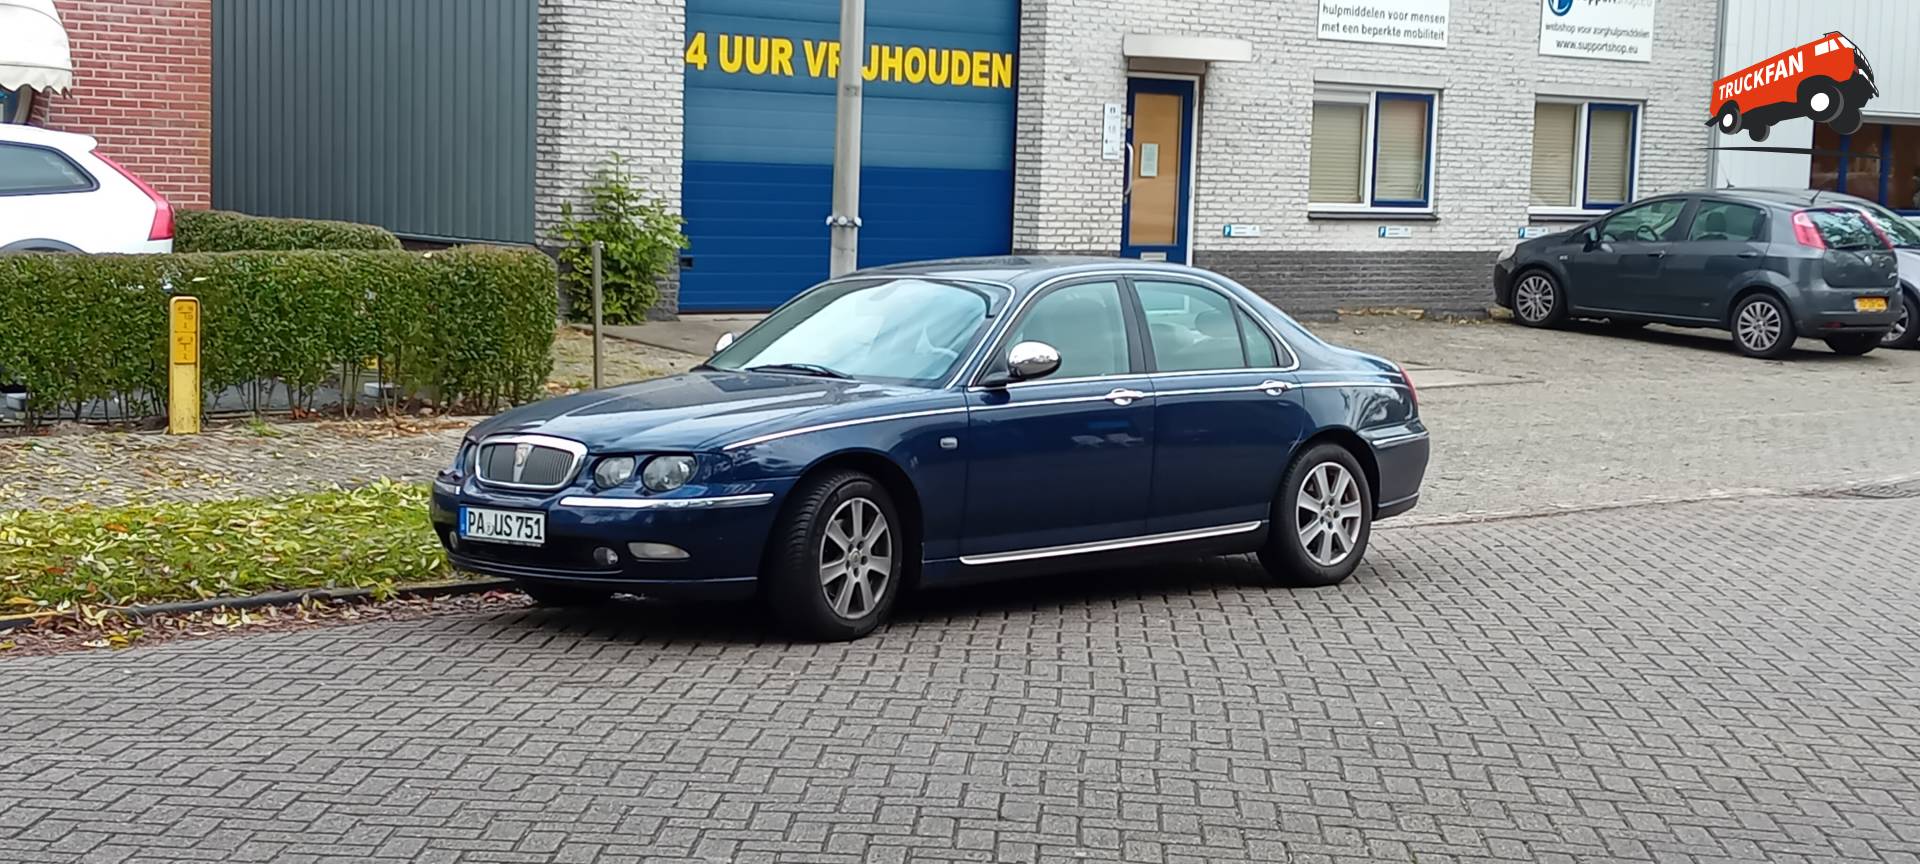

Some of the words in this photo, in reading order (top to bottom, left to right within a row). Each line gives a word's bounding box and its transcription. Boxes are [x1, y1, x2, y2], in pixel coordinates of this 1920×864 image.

[1322, 4, 1385, 19] hulpmiddelen
[1388, 10, 1408, 21] voor
[1410, 13, 1446, 24] mensen
[1321, 22, 1340, 33] met
[1342, 24, 1359, 34] een
[1361, 24, 1401, 38] beperkte
[1403, 29, 1444, 40] mobiliteit
[1577, 26, 1592, 34] voor
[718, 34, 794, 77] UUR
[1556, 39, 1638, 54] www.supportshop.eu
[468, 511, 485, 534] PA
[494, 513, 512, 537] US
[515, 516, 542, 540] 751
